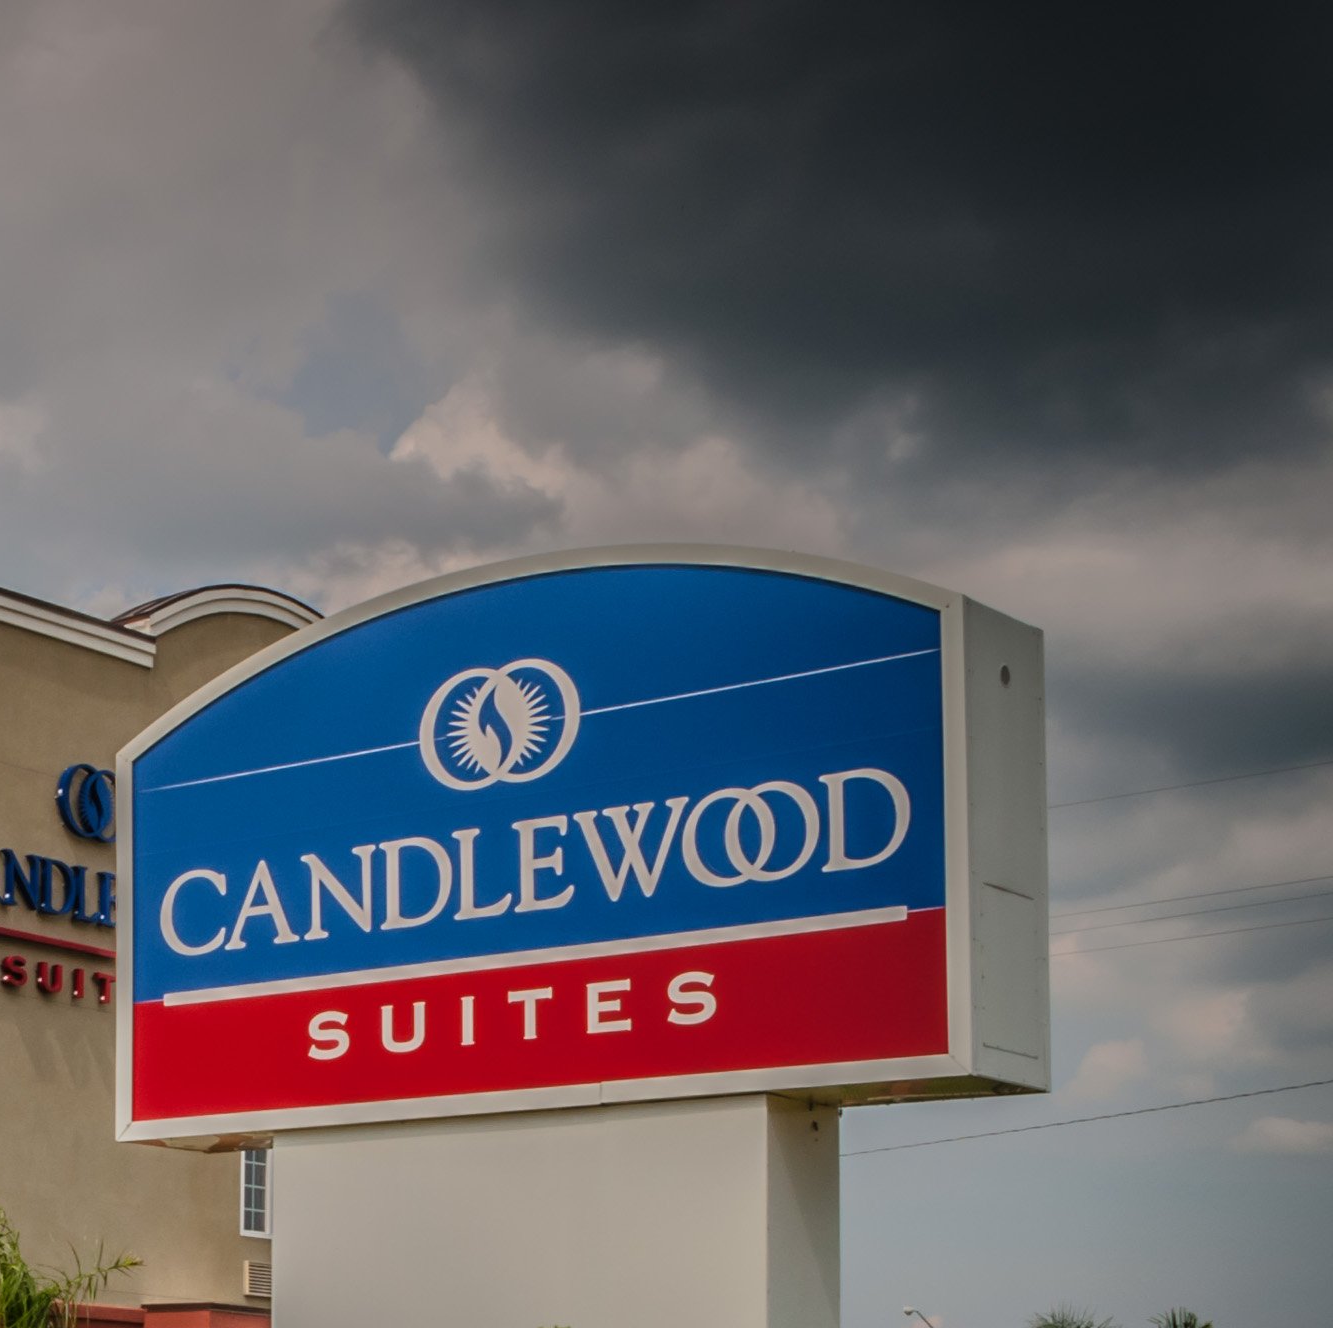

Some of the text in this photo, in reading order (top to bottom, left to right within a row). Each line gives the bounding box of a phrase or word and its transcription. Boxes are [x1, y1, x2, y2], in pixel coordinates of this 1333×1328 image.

[159, 768, 911, 957] CANDLEWOOD
[0, 955, 116, 1004] SUIT
[307, 971, 717, 1060] SUITES
